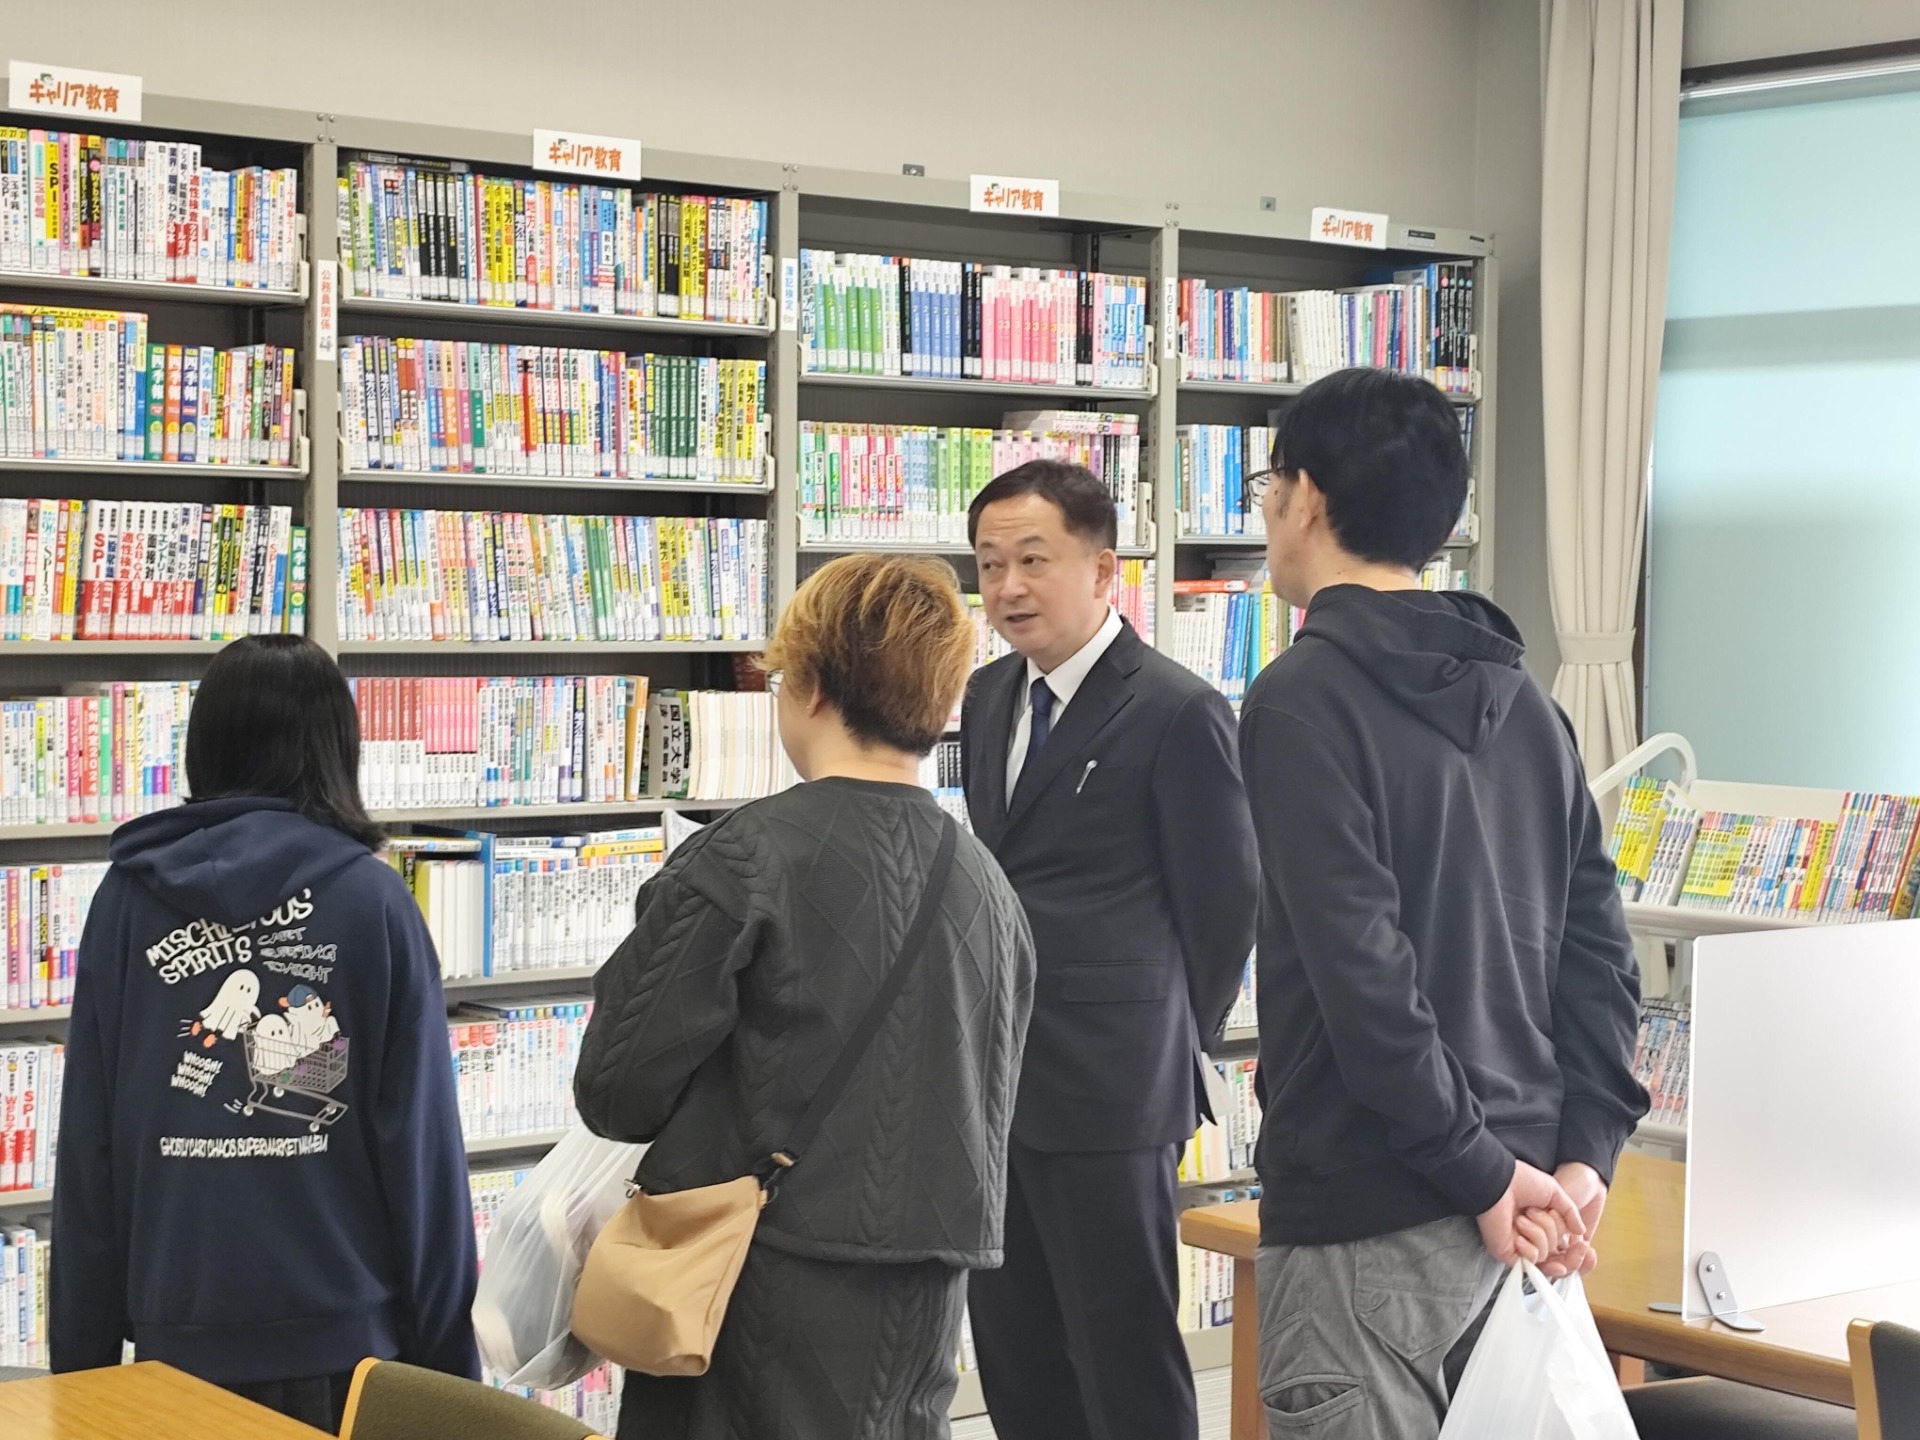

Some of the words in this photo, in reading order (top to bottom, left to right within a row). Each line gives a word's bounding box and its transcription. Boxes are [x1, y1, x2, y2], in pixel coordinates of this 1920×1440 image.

[29, 78, 119, 112] キャリア教育
[548, 142, 622, 171] キャリア教育
[49, 163, 59, 203] SPI
[984, 186, 1043, 211] キャリア教育
[1322, 218, 1373, 242] キャリア教育
[1166, 284, 1174, 335] TOEIC
[92, 533, 105, 579] SPI
[187, 538, 198, 580] 自己分析
[40, 545, 52, 597] SPI3
[669, 704, 682, 784] 国立大学
[159, 935, 252, 985] SPIRITS
[262, 960, 333, 984] TONIGHT
[177, 1062, 216, 1086] WHOOSH!
[183, 1050, 224, 1075] WHOOSH!
[459, 1050, 469, 1075] 商社
[484, 1049, 495, 1073] 商社
[171, 1074, 209, 1098] WHOOSH!
[23, 1090, 34, 1128] SPI
[207, 1138, 236, 1158] CHAOS
[237, 1137, 299, 1158] SUPERMARKET
